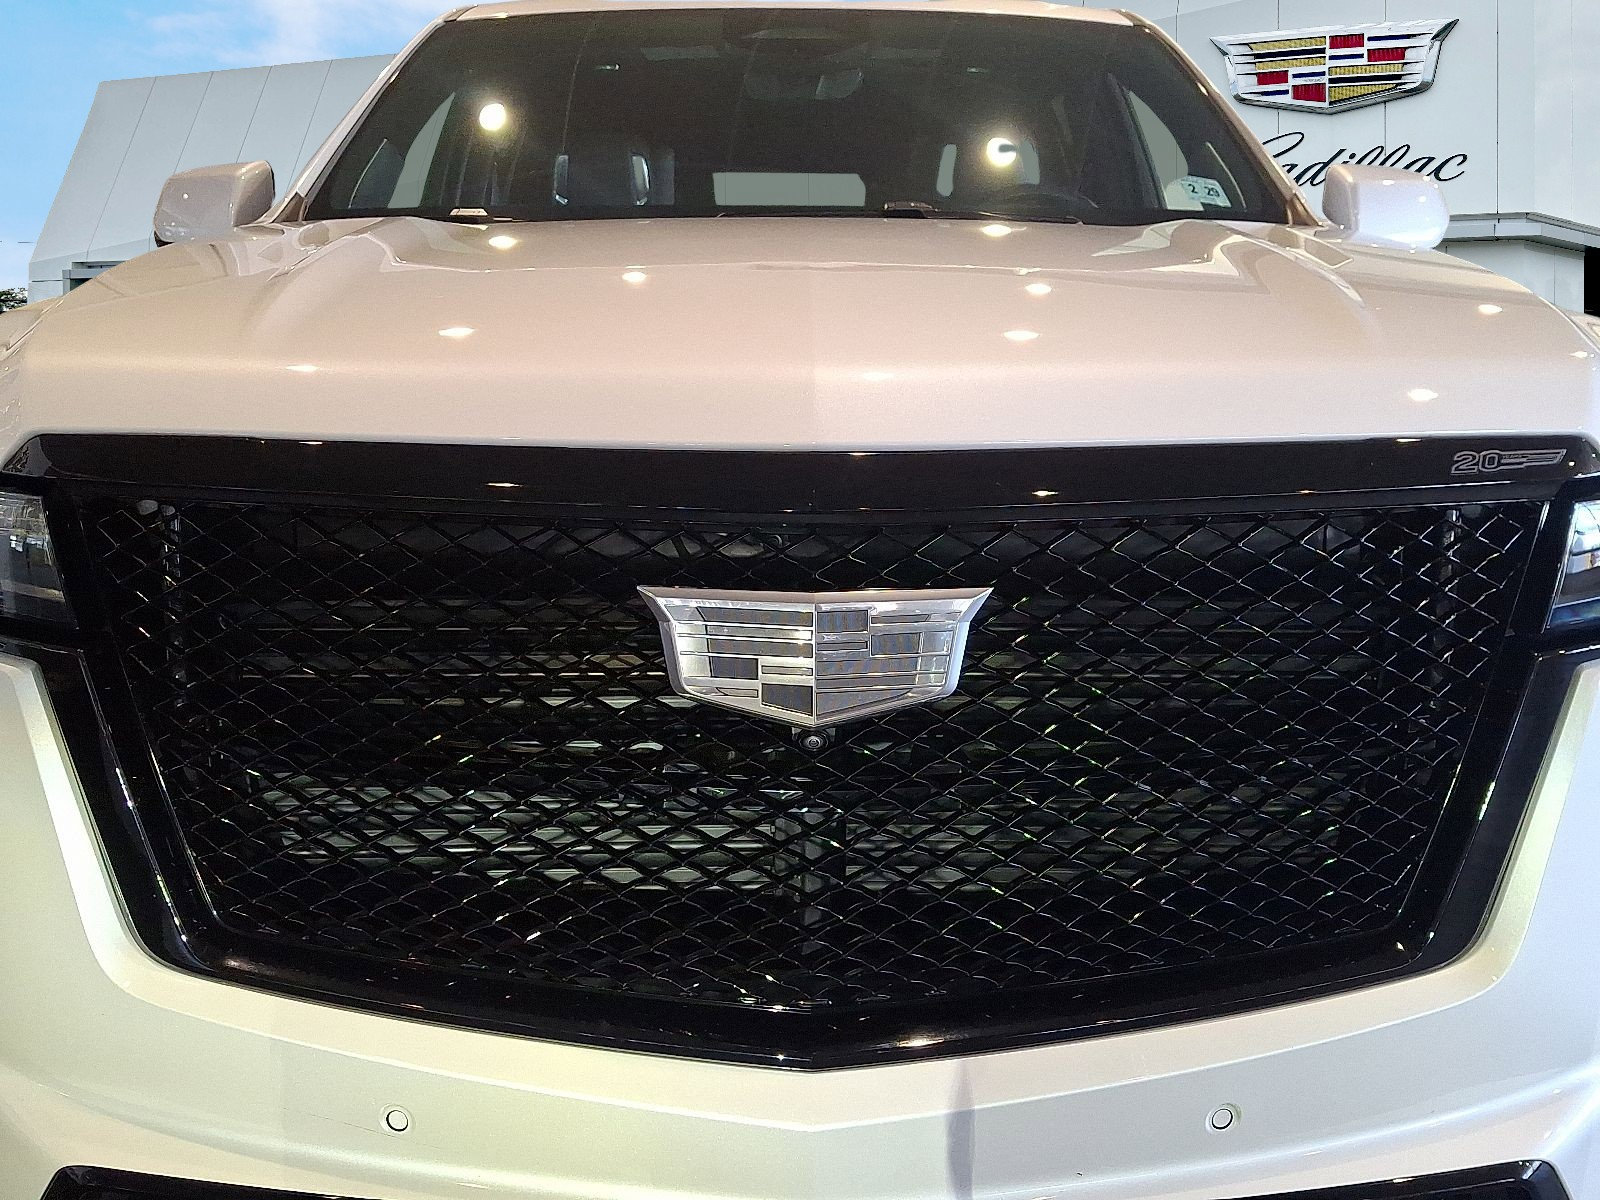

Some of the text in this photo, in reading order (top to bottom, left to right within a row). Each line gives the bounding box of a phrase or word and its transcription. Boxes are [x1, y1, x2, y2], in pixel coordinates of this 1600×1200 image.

[1262, 131, 1468, 187] Cadllac
[1187, 183, 1199, 194] 2
[1451, 449, 1500, 474] 20
